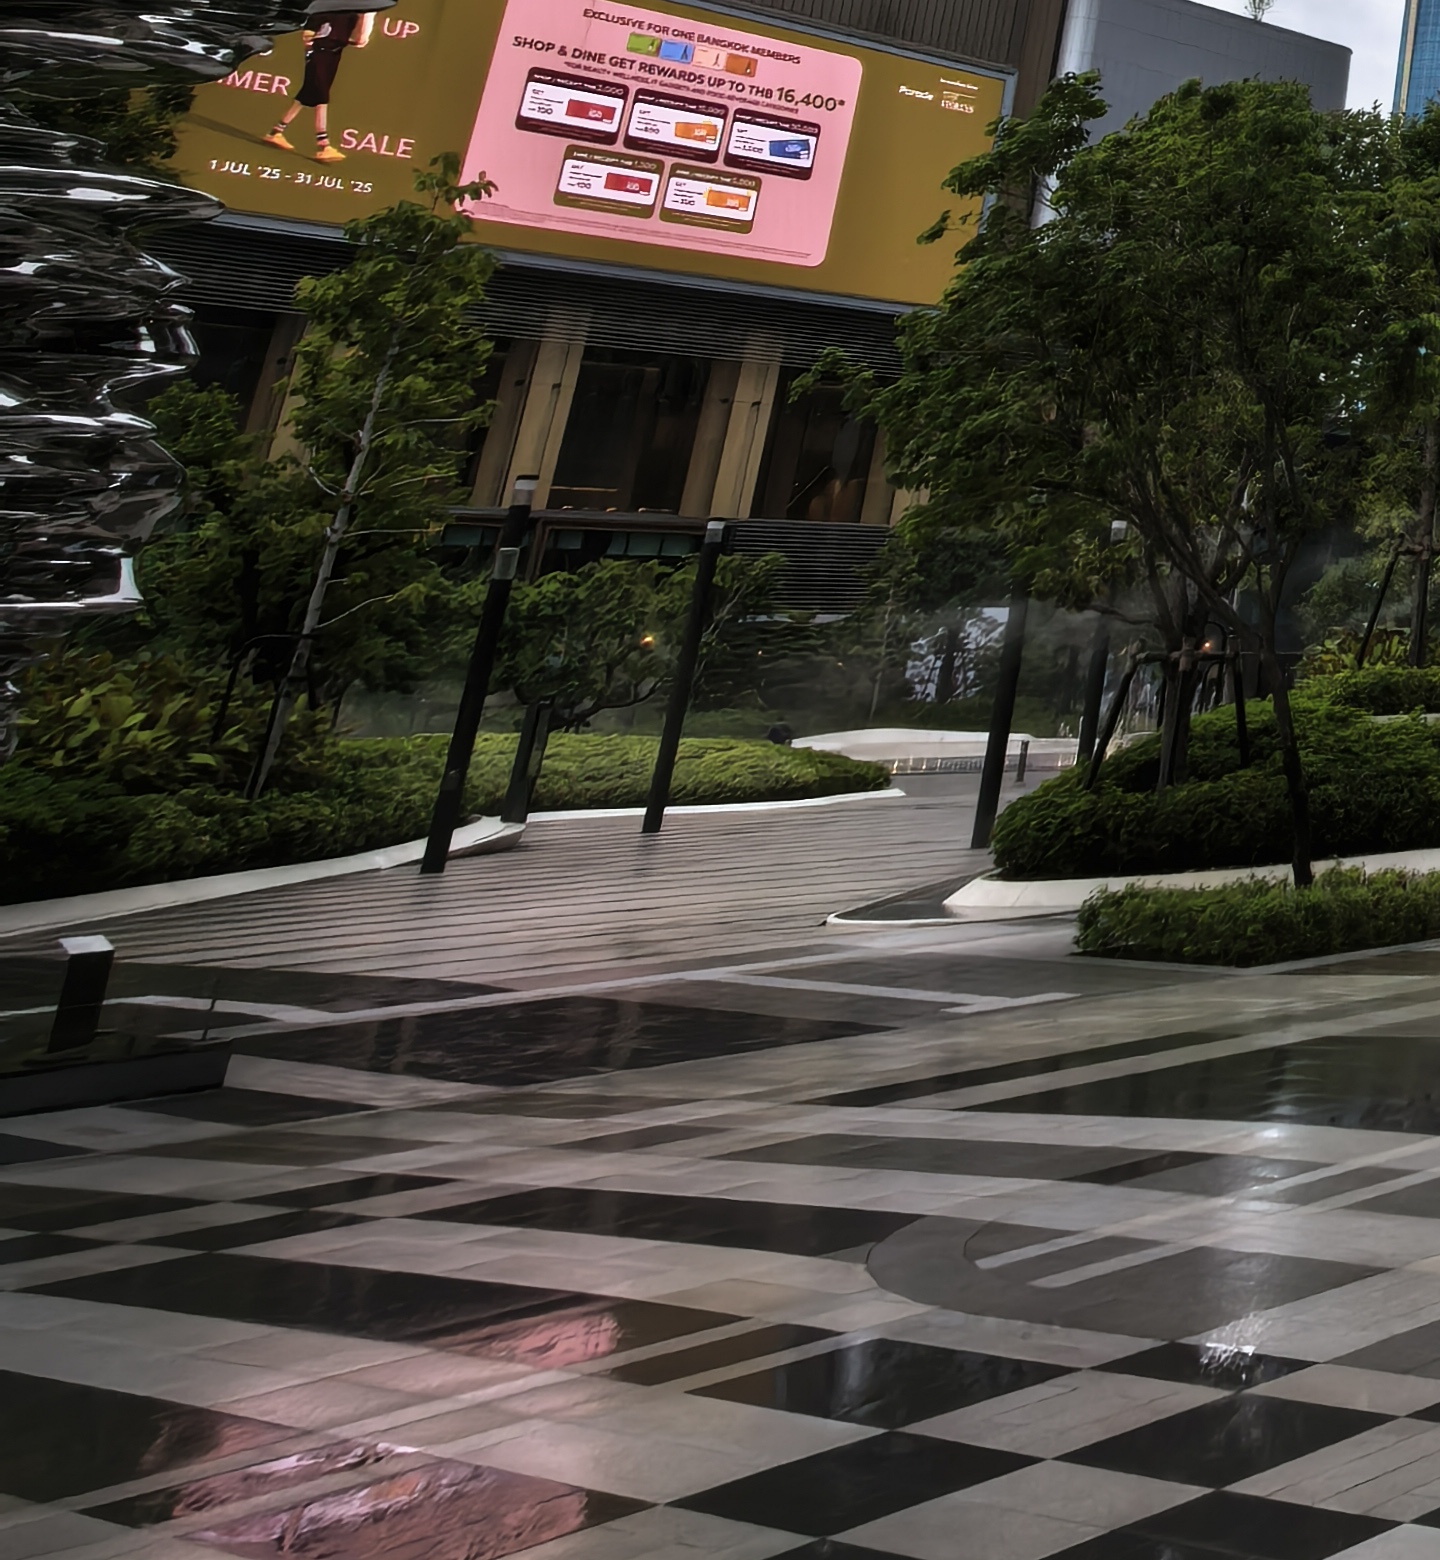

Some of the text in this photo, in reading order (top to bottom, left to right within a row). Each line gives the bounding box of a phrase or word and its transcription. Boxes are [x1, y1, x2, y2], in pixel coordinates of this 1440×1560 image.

[383, 17, 420, 39] UP
[583, 8, 645, 30] EXCLUSIVE
[647, 23, 670, 36] FOR
[671, 28, 695, 41] ONE
[696, 34, 750, 53] BANGKOK
[216, 70, 292, 96] MER
[512, 35, 555, 52] SHOP
[557, 45, 568, 57] &
[571, 48, 607, 64] DINE
[608, 55, 637, 71] GET
[638, 61, 705, 85] REWARDS
[707, 74, 727, 88] UP
[728, 81, 746, 94] TO
[748, 85, 774, 99] THB
[339, 128, 416, 159] SALE
[209, 159, 218, 171] 1
[220, 161, 251, 176] JUL
[257, 165, 281, 179] '25
[294, 172, 311, 185] 31
[315, 175, 344, 190] JUL
[350, 179, 373, 194] '25
